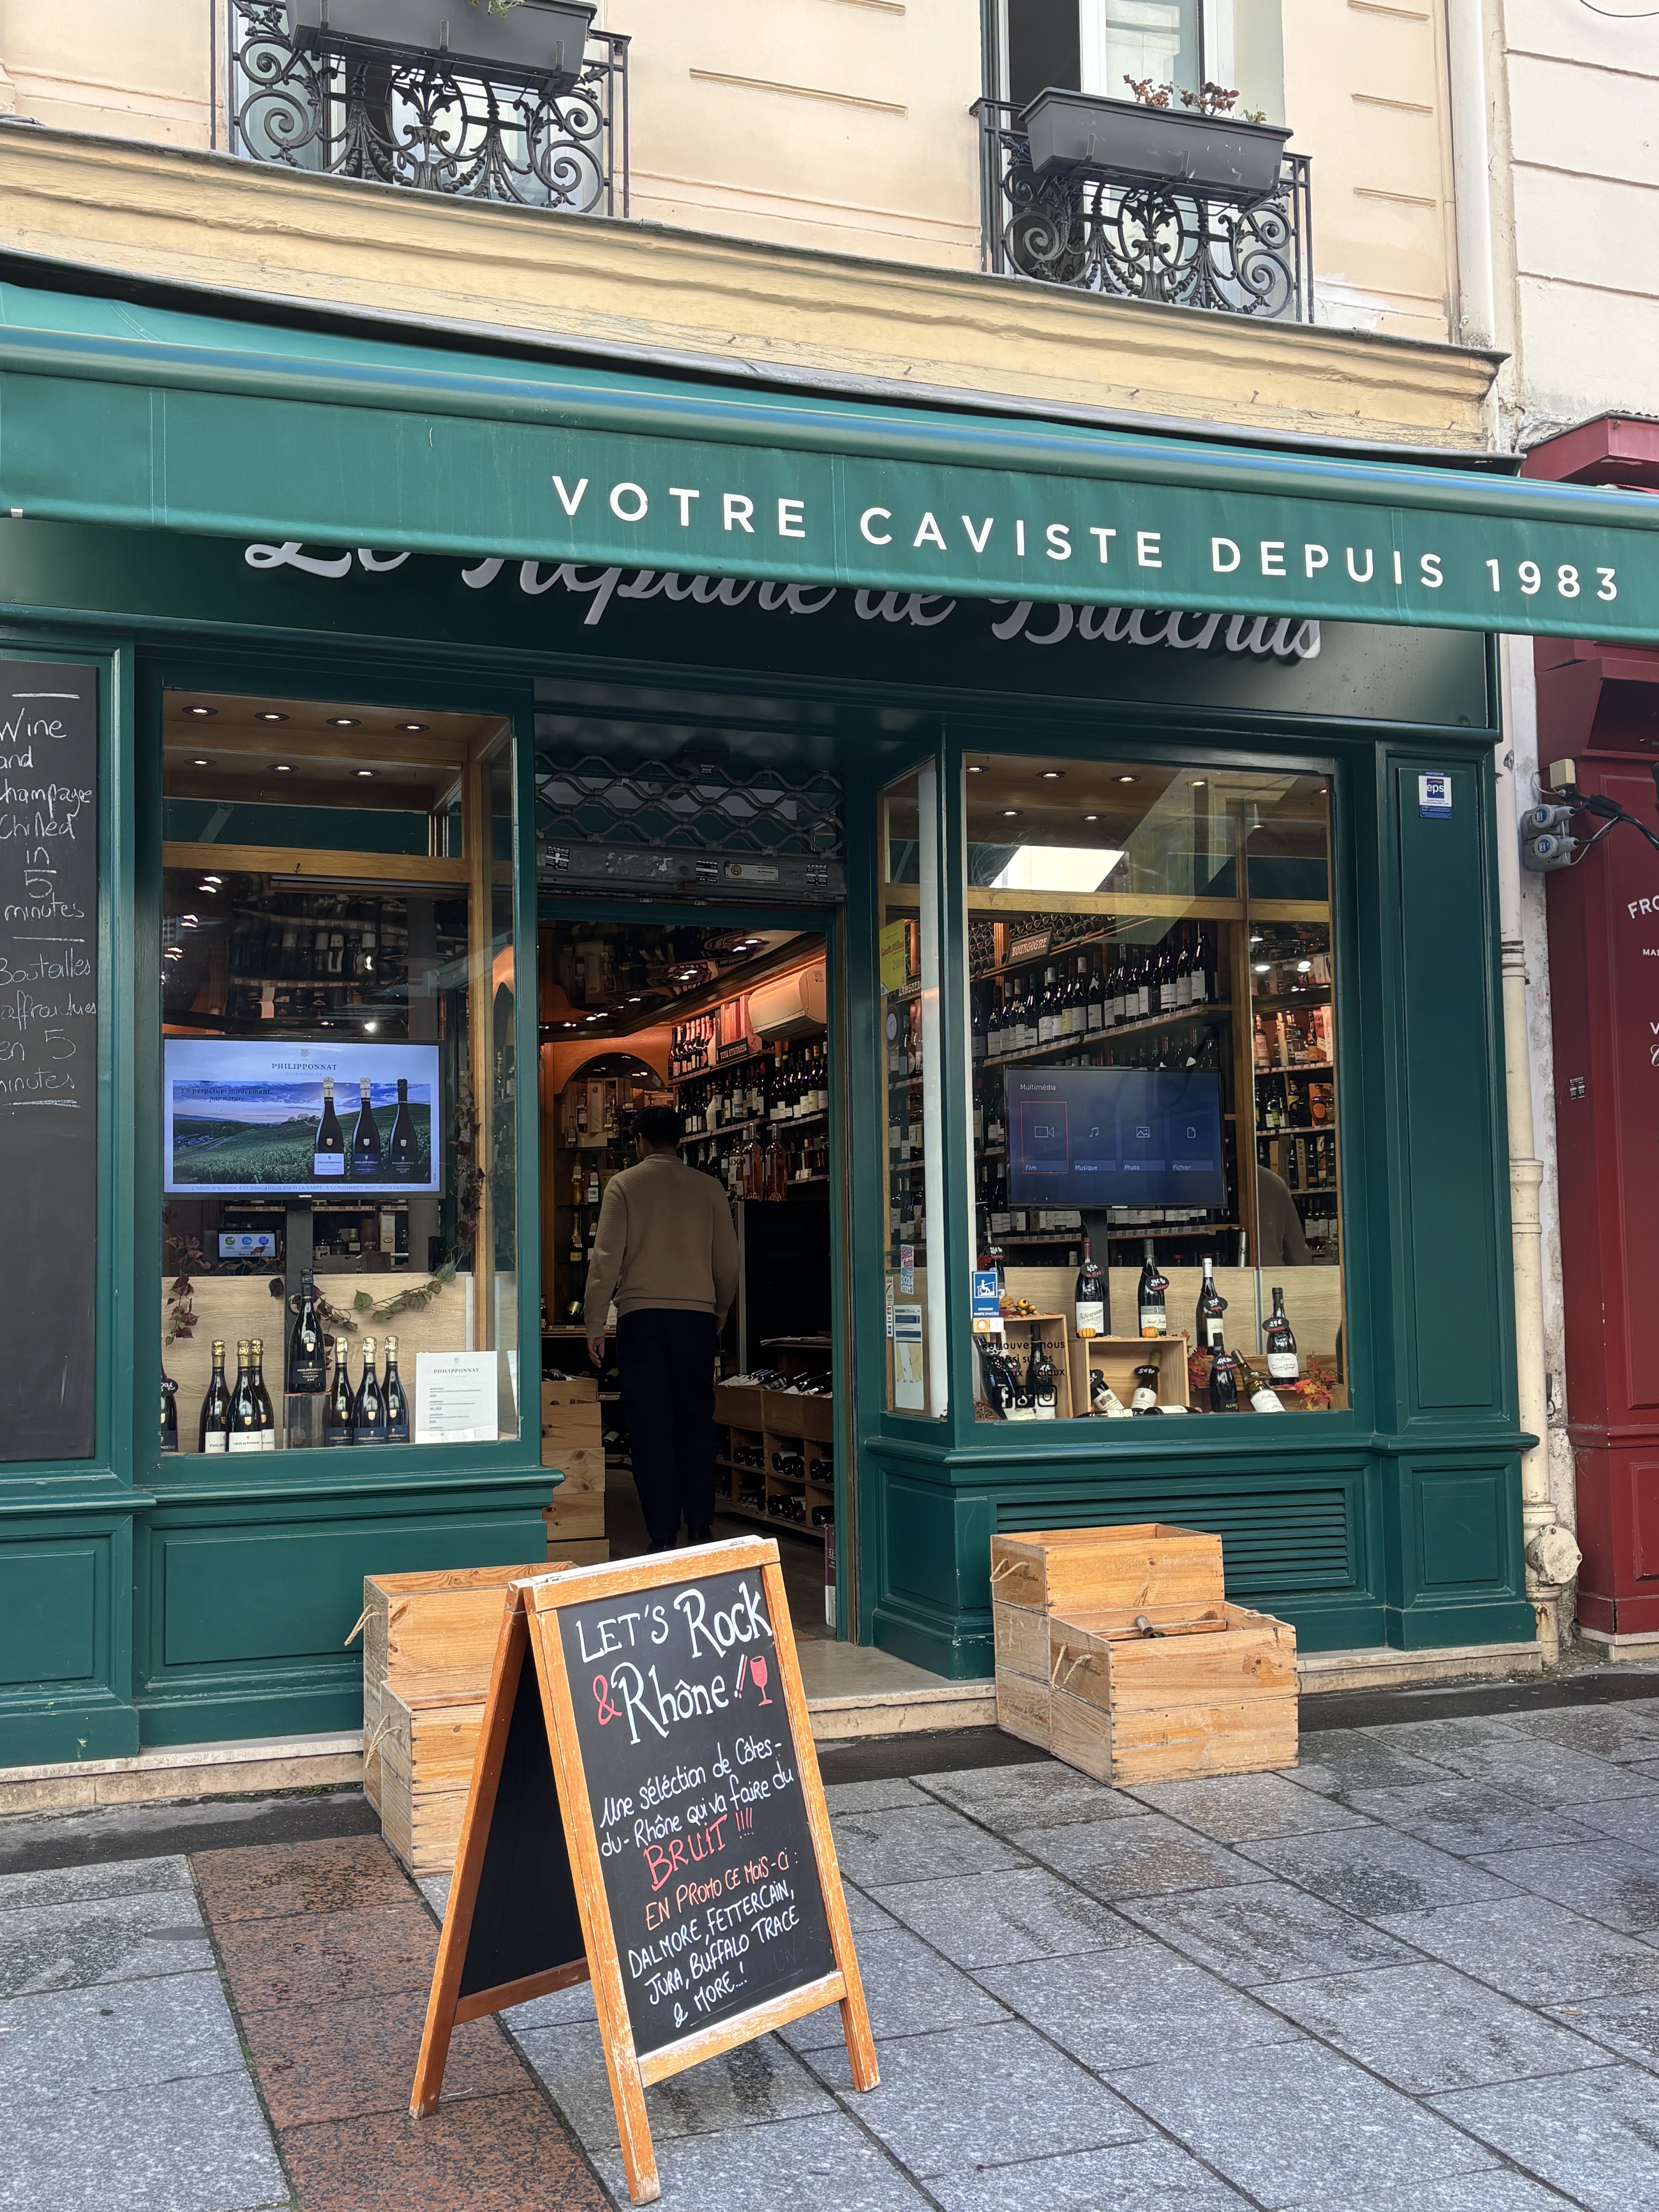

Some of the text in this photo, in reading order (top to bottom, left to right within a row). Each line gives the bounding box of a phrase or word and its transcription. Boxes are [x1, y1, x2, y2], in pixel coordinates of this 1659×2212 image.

[551, 475, 1618, 601] VOTRE CAVISTE DEPUIS 1983
[0, 745, 33, 769] and
[1427, 784, 1444, 794] eps
[0, 811, 76, 839] Chilled
[26, 843, 50, 865] in
[24, 869, 57, 898] 5
[4, 893, 85, 921] minutes
[0, 1029, 76, 1061] en 5
[575, 1604, 669, 1663] LET'S
[600, 1796, 634, 1828] Une
[713, 1742, 732, 1778] de
[687, 1797, 708, 1826] qui
[773, 1760, 794, 1790] du
[645, 1897, 670, 1931] EN
[675, 1878, 722, 1913] PROMO
[725, 1868, 741, 1890] CE
[644, 1905, 800, 2005] JURA, BUFFALO TRACE
